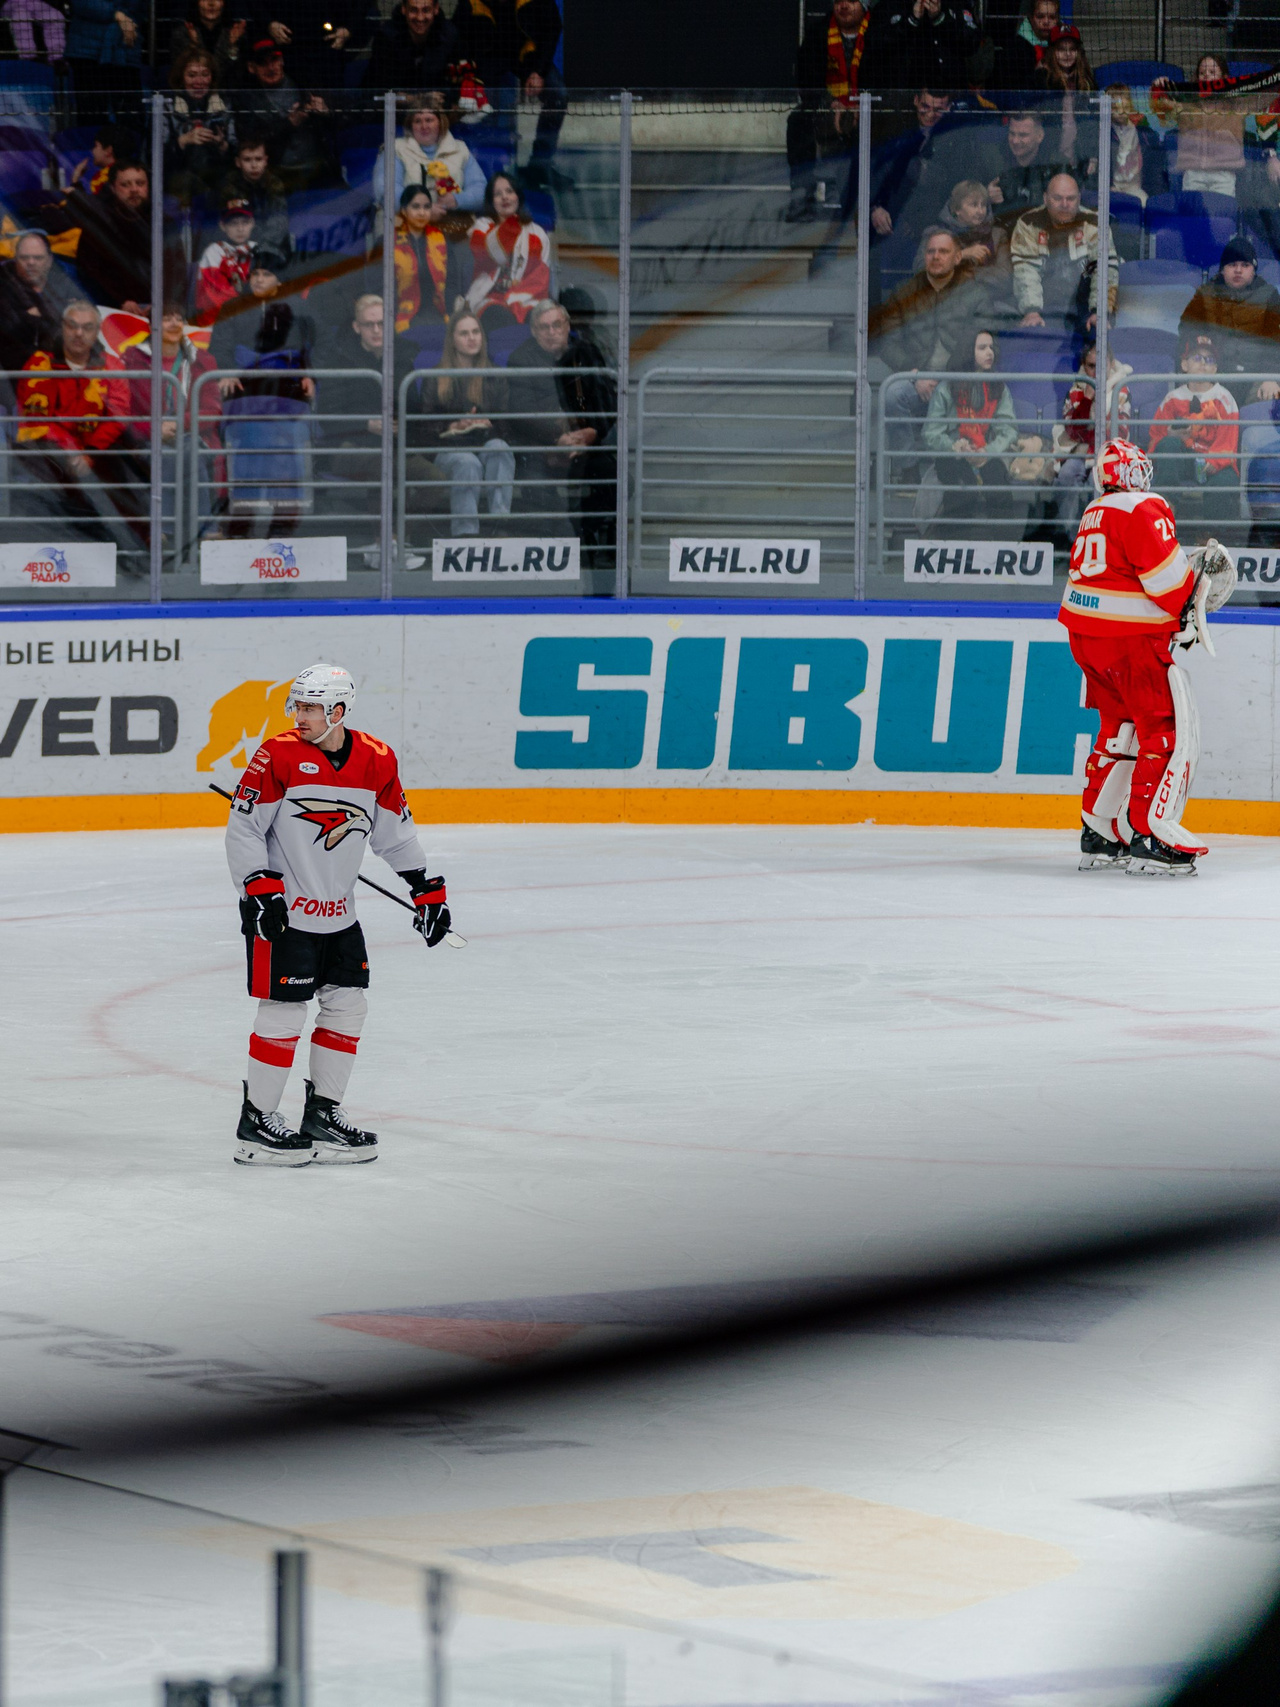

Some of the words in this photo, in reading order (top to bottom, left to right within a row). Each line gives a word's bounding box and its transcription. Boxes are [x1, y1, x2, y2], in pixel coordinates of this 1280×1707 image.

[22, 562, 55, 573] АВТО
[250, 557, 283, 569] АВТО
[259, 566, 300, 579] РАДИО
[441, 546, 571, 573] KHL.RU
[678, 546, 811, 574] KHL.RU
[913, 547, 1044, 577] KHL.RU
[31, 572, 71, 583] РАДИО
[1068, 590, 1100, 609] SIBUR
[67, 637, 181, 664] ШИНЫ
[229, 783, 262, 816] 13
[1154, 769, 1175, 819] CCM
